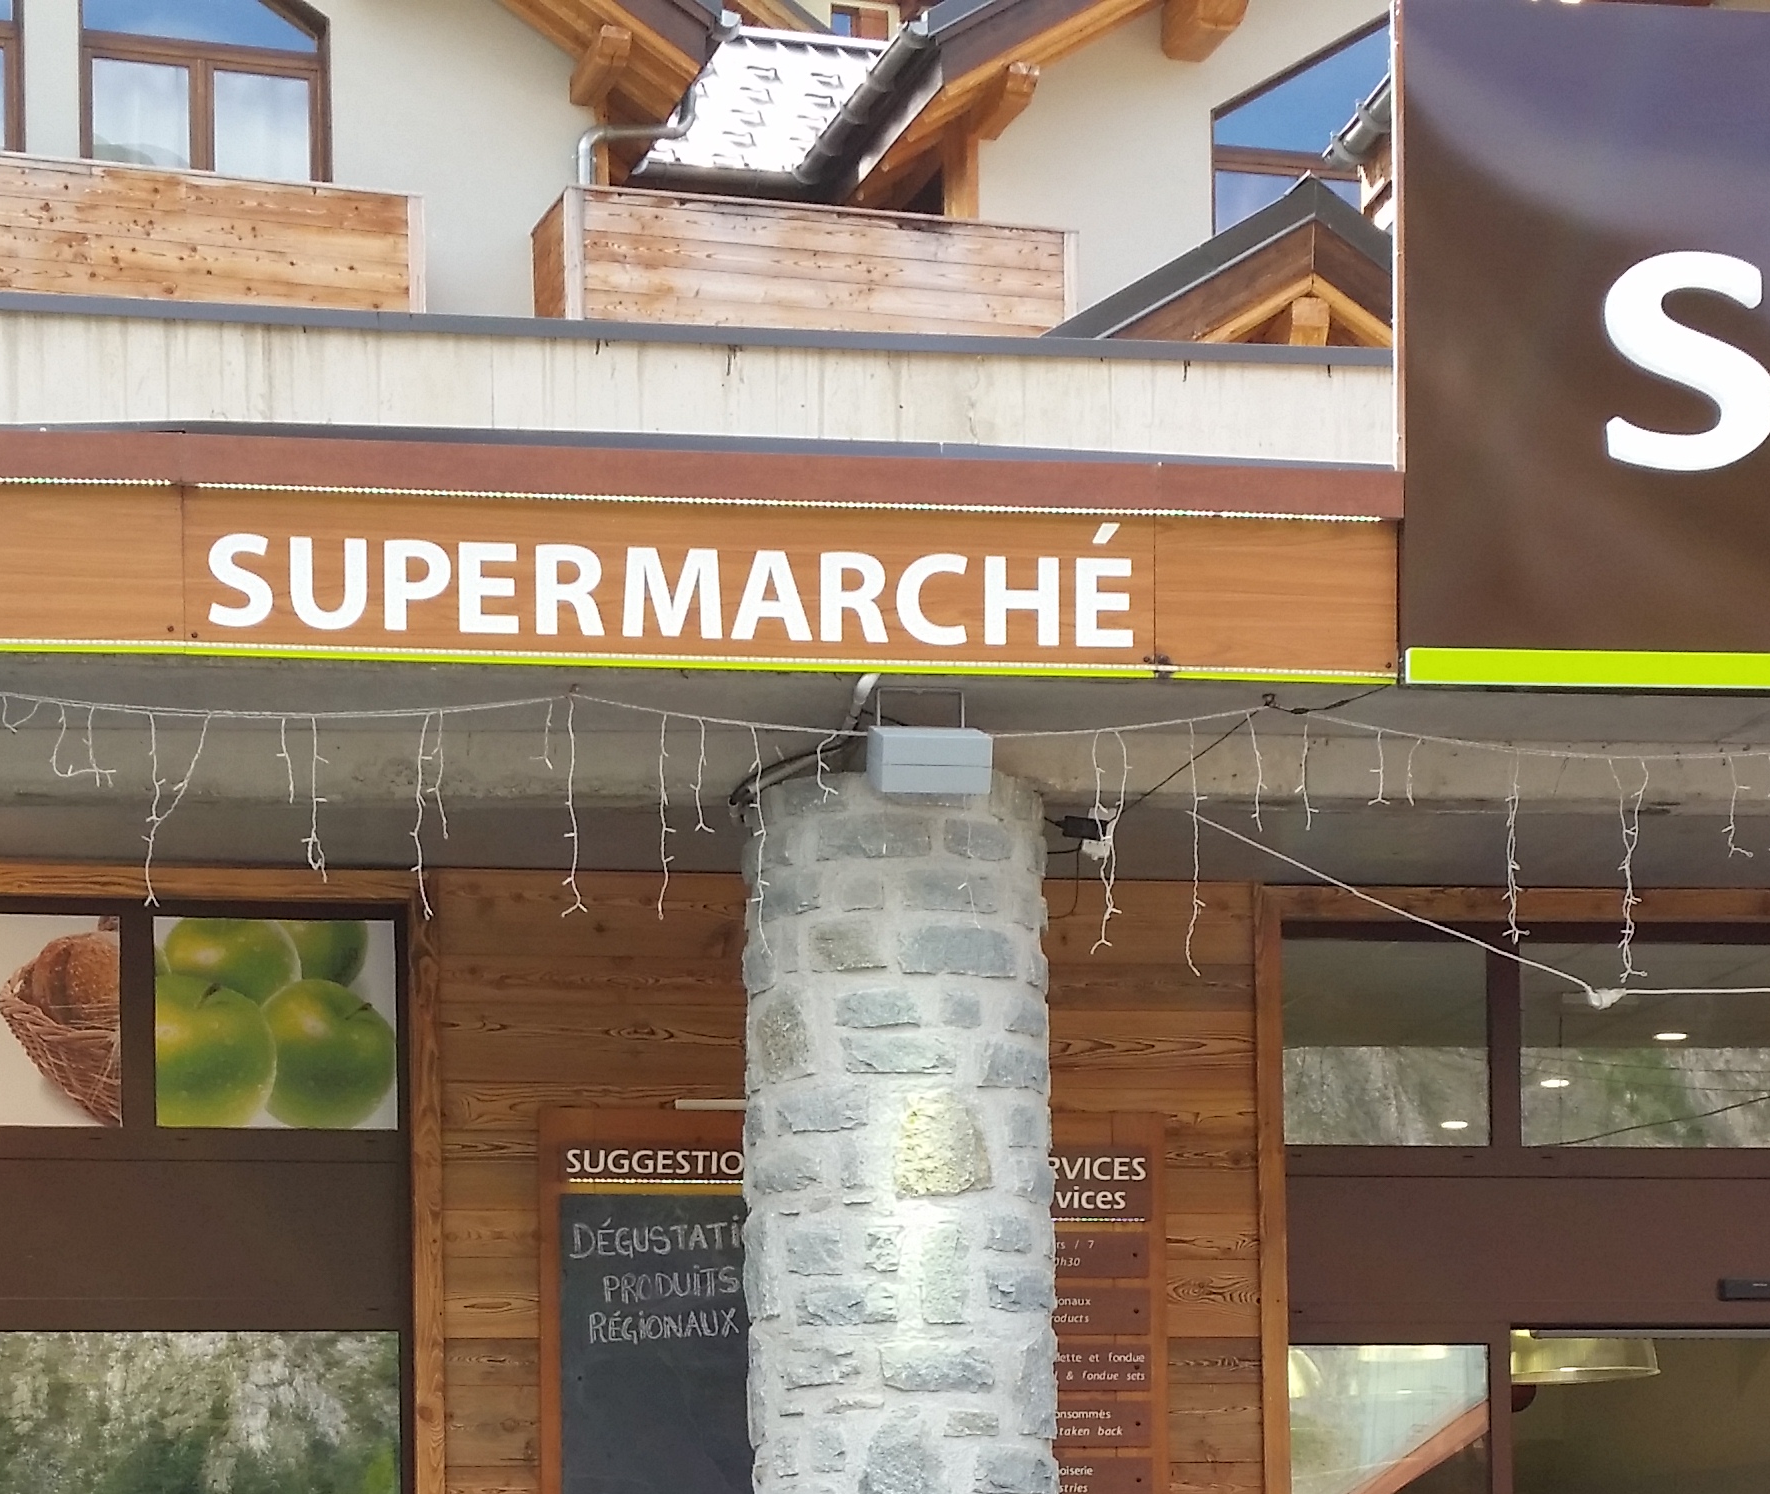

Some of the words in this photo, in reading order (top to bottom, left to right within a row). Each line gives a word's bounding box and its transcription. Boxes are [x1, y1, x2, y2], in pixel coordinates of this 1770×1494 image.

[207, 522, 1134, 649] SUPERMARCHÉ
[566, 1149, 745, 1175] SUGGESTIO
[1048, 1156, 1147, 1181] RVICES
[1055, 1185, 1127, 1210] vices
[1054, 1257, 1081, 1267] 0h30
[1058, 1297, 1091, 1306] onaux
[1051, 1313, 1090, 1323] roducts
[1108, 1352, 1145, 1363] fondue
[1082, 1371, 1119, 1380] fondue
[1055, 1410, 1111, 1419] onsommés
[1059, 1426, 1090, 1436] taken
[1097, 1426, 1123, 1436] back
[1059, 1465, 1094, 1476] oiserie
[1059, 1483, 1089, 1493] stries
